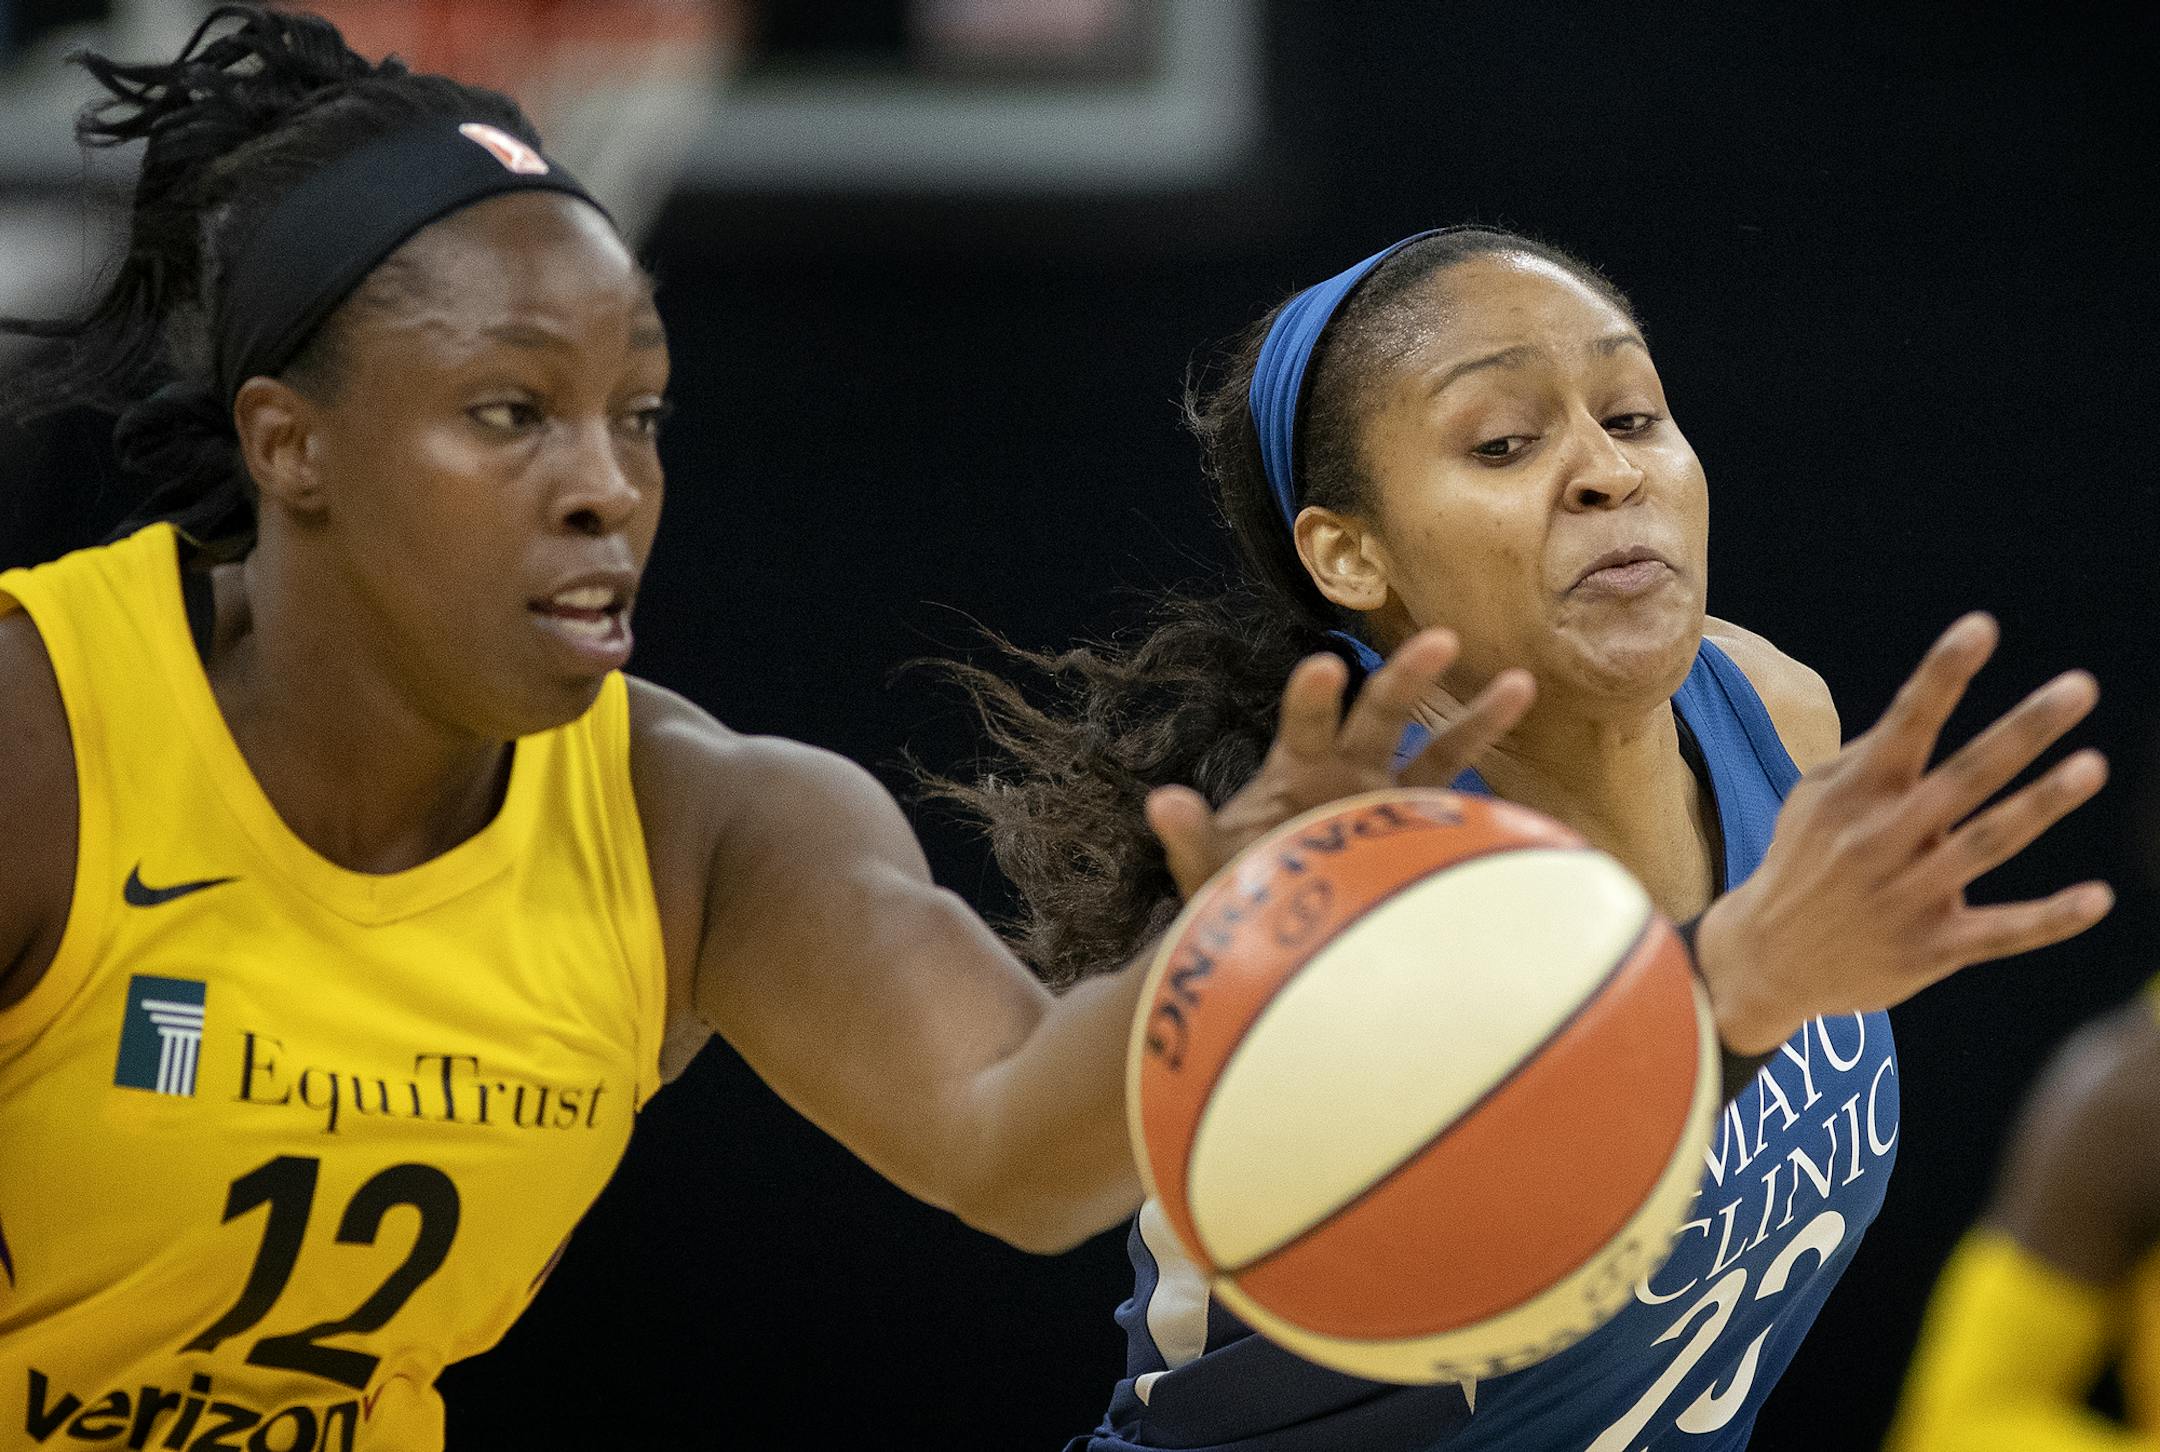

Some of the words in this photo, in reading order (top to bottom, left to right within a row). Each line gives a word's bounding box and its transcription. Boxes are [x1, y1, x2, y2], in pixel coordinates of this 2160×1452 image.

[1145, 801, 1466, 1072] PALING
[238, 1030, 608, 1135] EquiTrust
[1634, 1056, 1898, 1304] CLINIC
[1691, 1010, 1865, 1197] MAYO
[178, 1155, 461, 1390] 12
[25, 1367, 360, 1452] verizon
